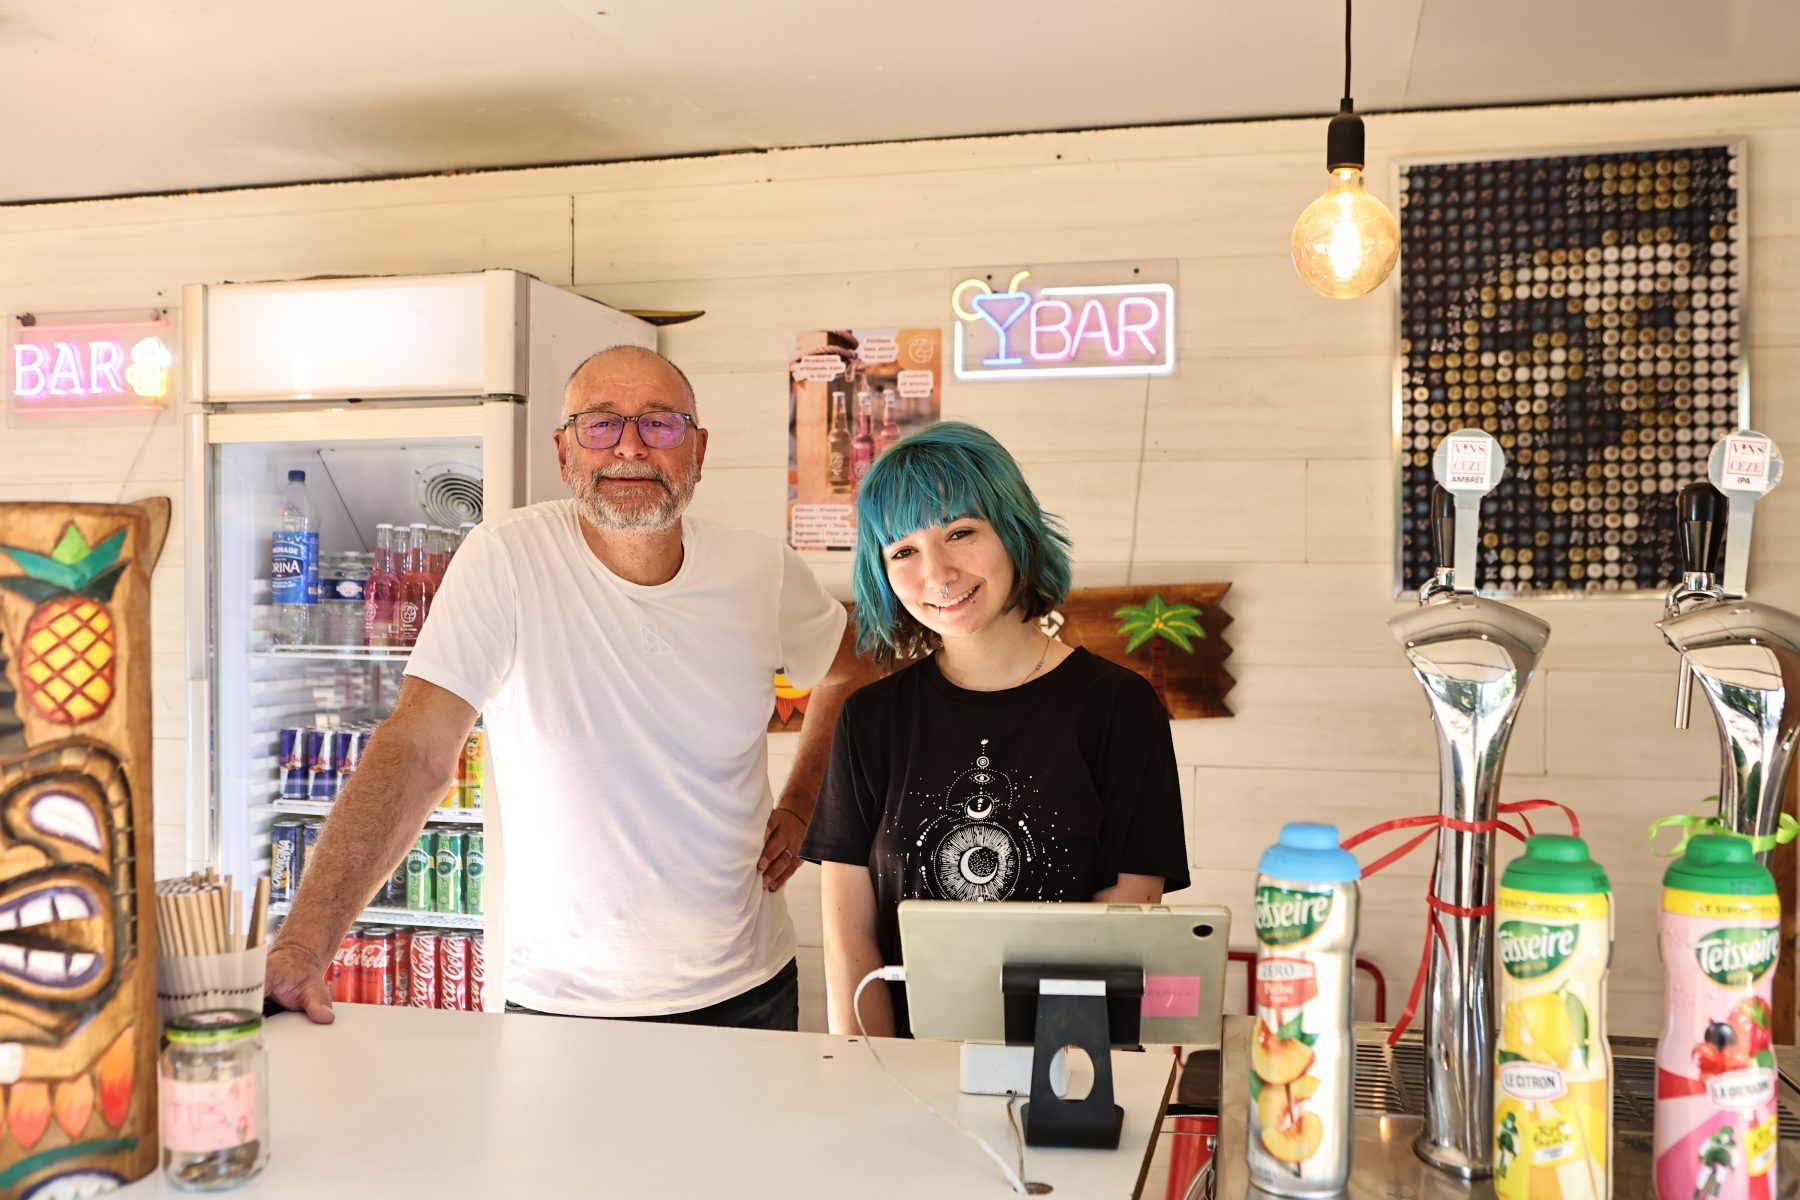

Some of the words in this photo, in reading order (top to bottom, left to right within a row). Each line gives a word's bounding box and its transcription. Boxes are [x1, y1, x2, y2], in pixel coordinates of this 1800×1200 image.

[1030, 297, 1159, 360] BAR
[13, 340, 124, 396] BAR
[1737, 477, 1751, 485] IPA
[1497, 926, 1575, 963] Teisseire
[1262, 964, 1295, 978] ZERO
[1504, 1072, 1514, 1088] LE
[1516, 1074, 1557, 1090] CITRON
[1714, 1084, 1726, 1099] LA
